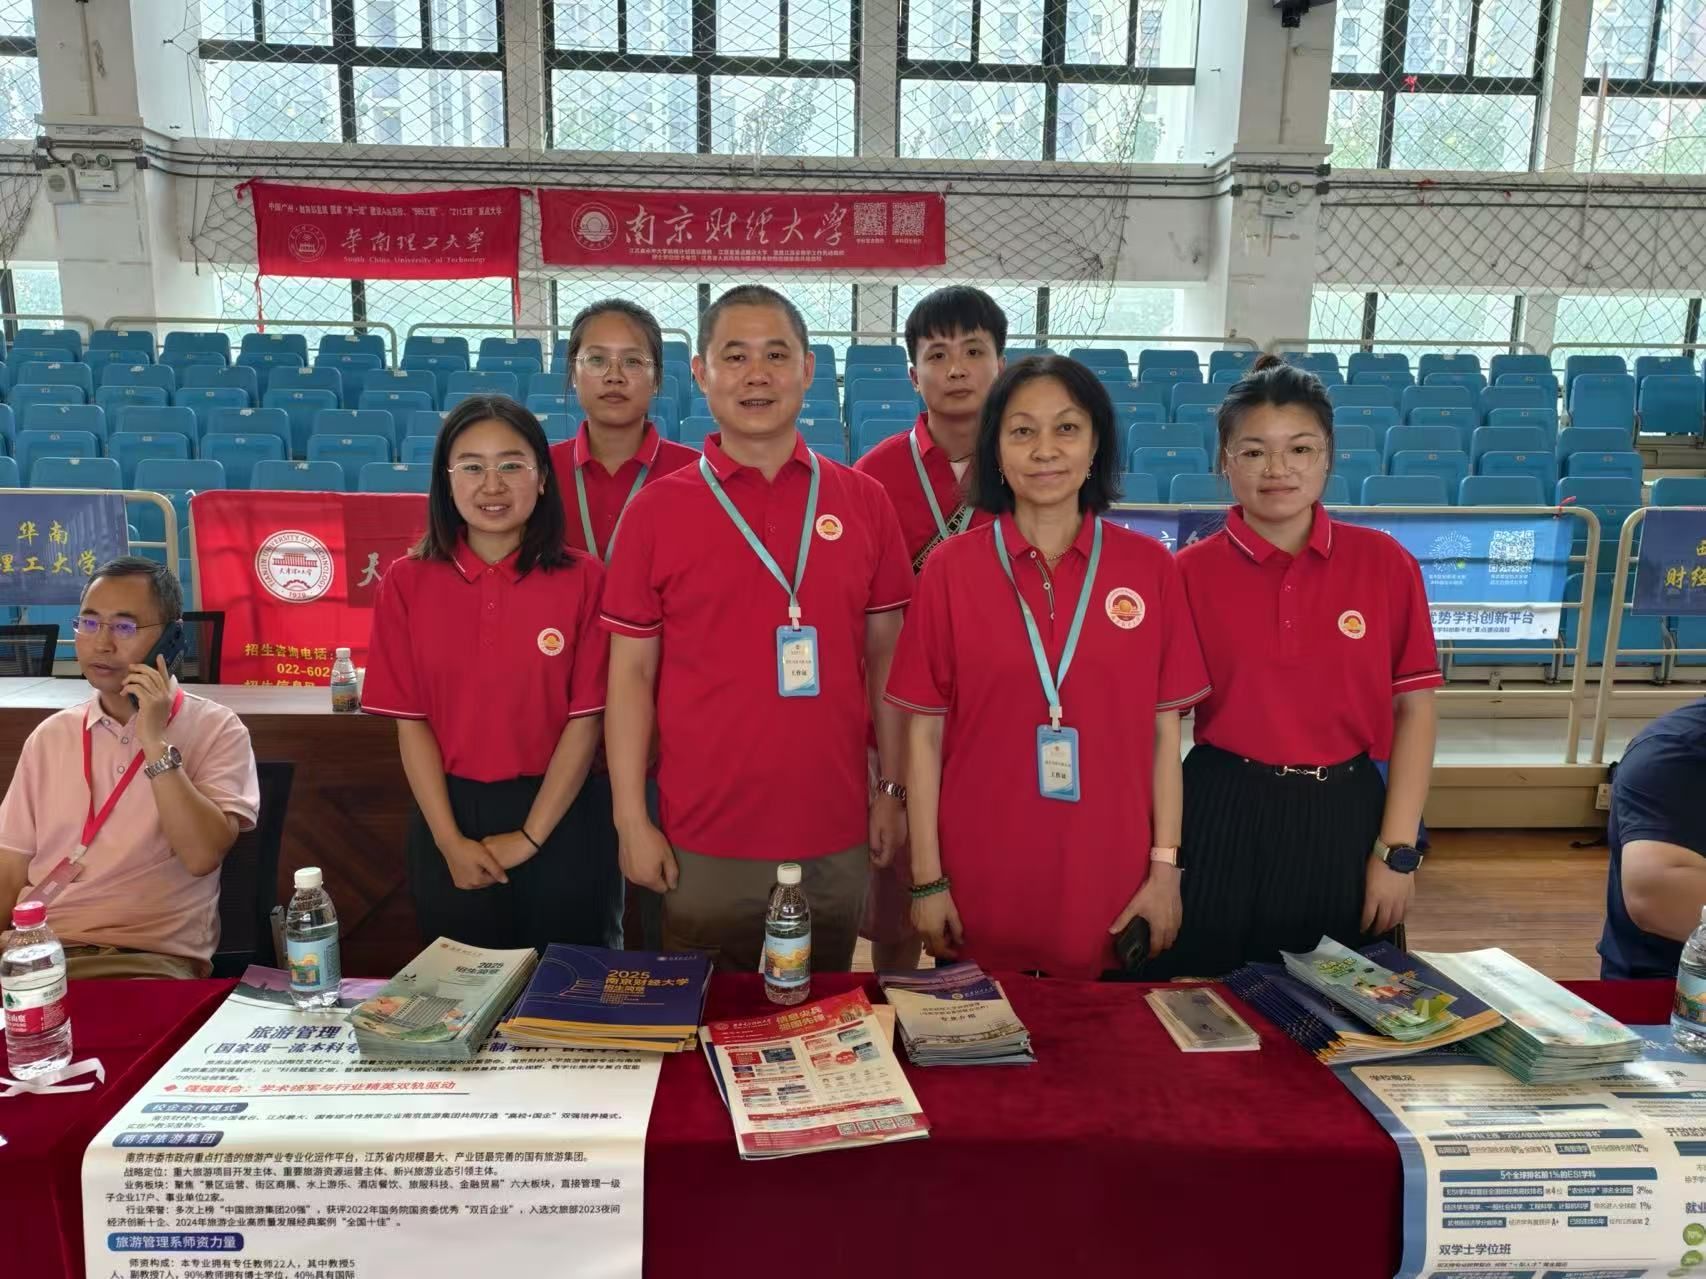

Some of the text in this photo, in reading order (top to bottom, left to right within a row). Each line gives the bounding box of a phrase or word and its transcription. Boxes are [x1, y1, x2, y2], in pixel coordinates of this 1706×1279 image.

[368, 256, 393, 264] China
[394, 256, 432, 264] University
[446, 256, 486, 265] Technology
[17, 520, 69, 545] 华南
[262, 534, 300, 557] UNIVERSITY
[260, 558, 276, 587] TIANJIN
[608, 969, 651, 979] 2025
[605, 977, 689, 987] 南京财经大学
[151, 1103, 238, 1113] 校企合作模式
[120, 1132, 217, 1145] 南京旅游集团
[115, 1235, 237, 1250] 旅游管理系师资力量
[1438, 1243, 1512, 1256] 双学士学位班
